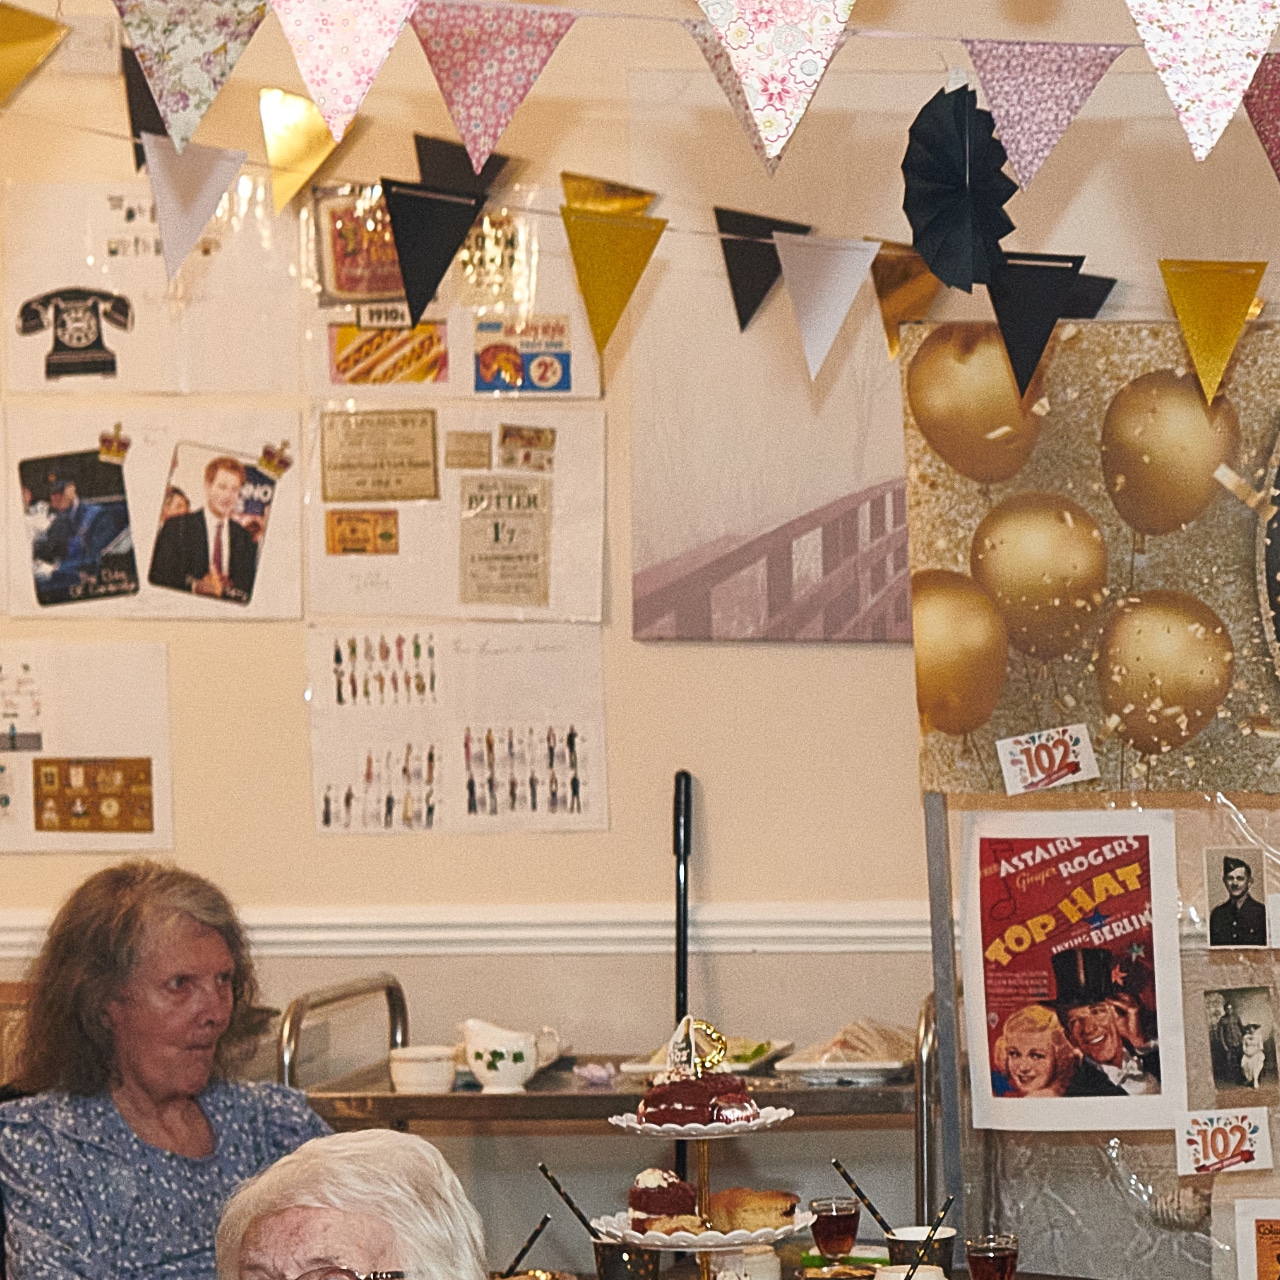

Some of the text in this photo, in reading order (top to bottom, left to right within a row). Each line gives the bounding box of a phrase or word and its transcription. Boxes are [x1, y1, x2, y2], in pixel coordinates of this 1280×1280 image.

[1020, 738, 1071, 777] 102
[999, 837, 1082, 878] ASTAIRE
[1015, 835, 1140, 893] Ginger ROGERS
[984, 913, 1057, 967] TOP
[1057, 862, 1143, 924] HAT
[1052, 934, 1090, 954] IRVING
[1089, 908, 1153, 946] BERLIN
[1196, 1124, 1247, 1161] 102
